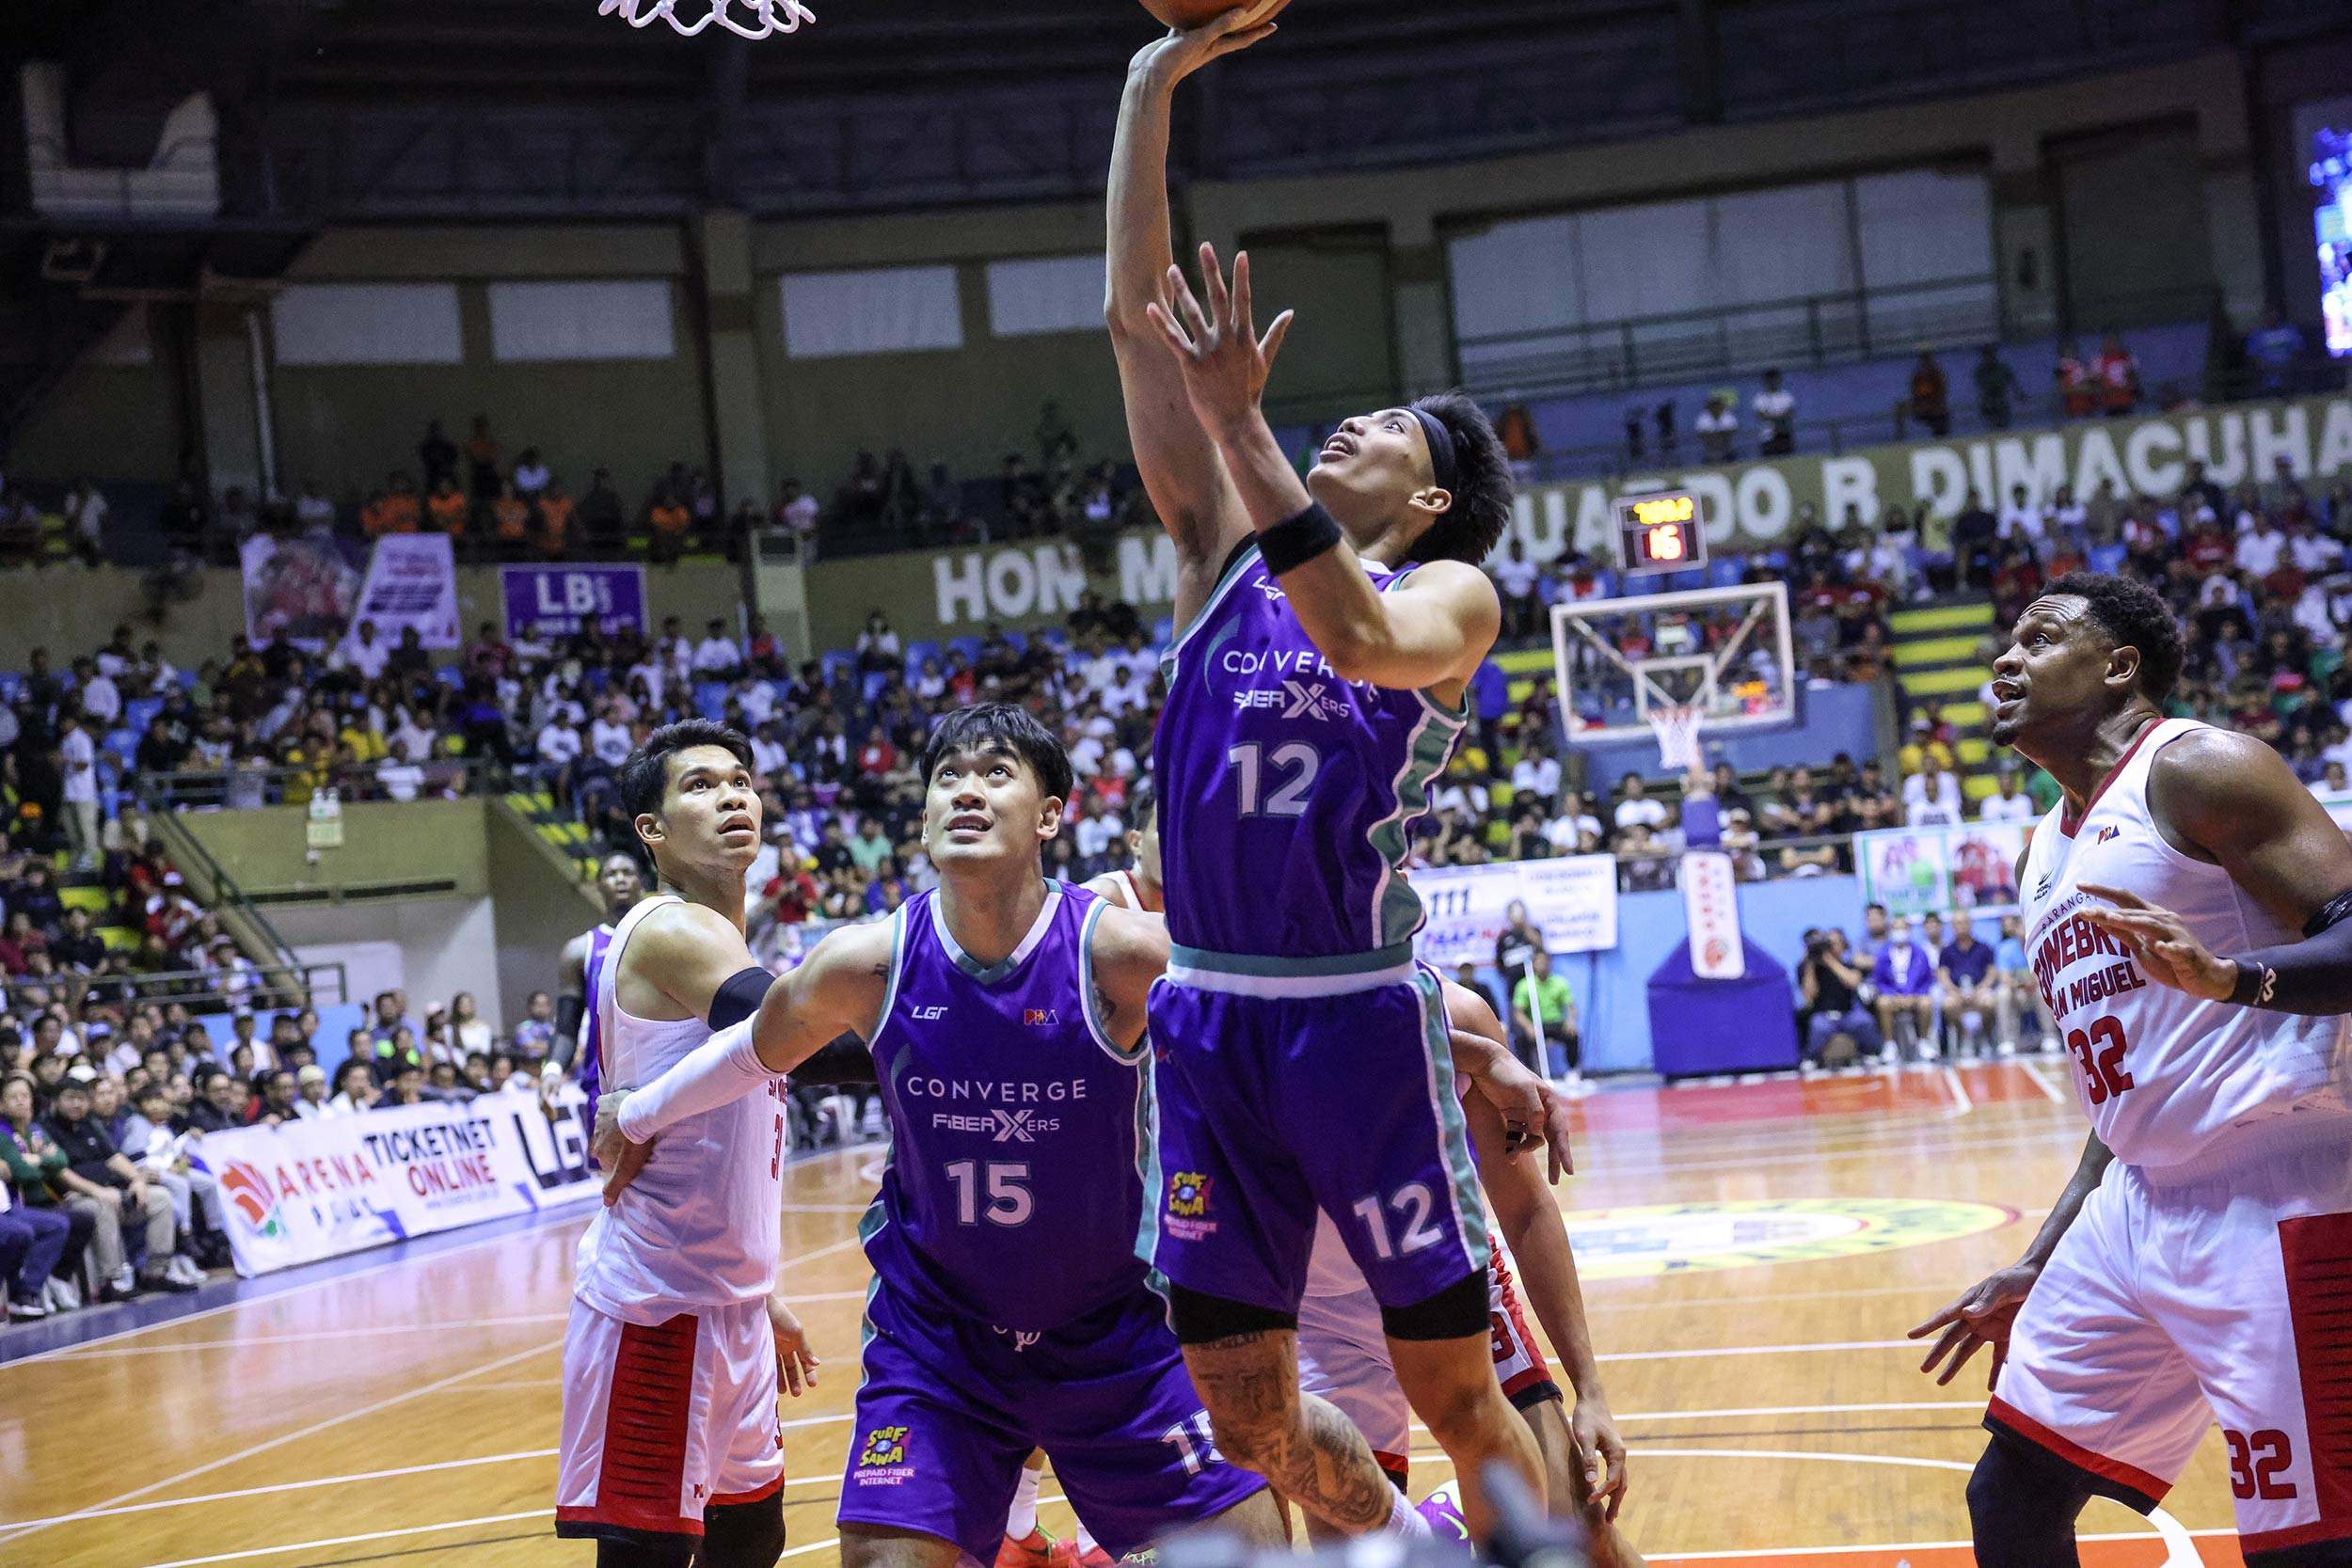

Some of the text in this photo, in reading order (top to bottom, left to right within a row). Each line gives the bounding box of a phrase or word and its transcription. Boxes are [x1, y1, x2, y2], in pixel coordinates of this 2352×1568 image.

[1229, 740, 1321, 816] 12
[2069, 960, 2147, 1011] MIGUEL
[2067, 1015, 2135, 1105] 32
[907, 1076, 1087, 1102] CONVERGE
[363, 1118, 496, 1164] TICKETNET
[276, 1151, 375, 1200] ARENA
[406, 1154, 496, 1196] ONLINE
[944, 1159, 1035, 1227] 15
[1354, 1181, 1444, 1261] 12
[859, 1446, 903, 1466] SAWA
[867, 1426, 908, 1447] SURF
[859, 1477, 902, 1485] INTERNET
[887, 1467, 914, 1477] FIBER
[2223, 1429, 2297, 1500] 32
